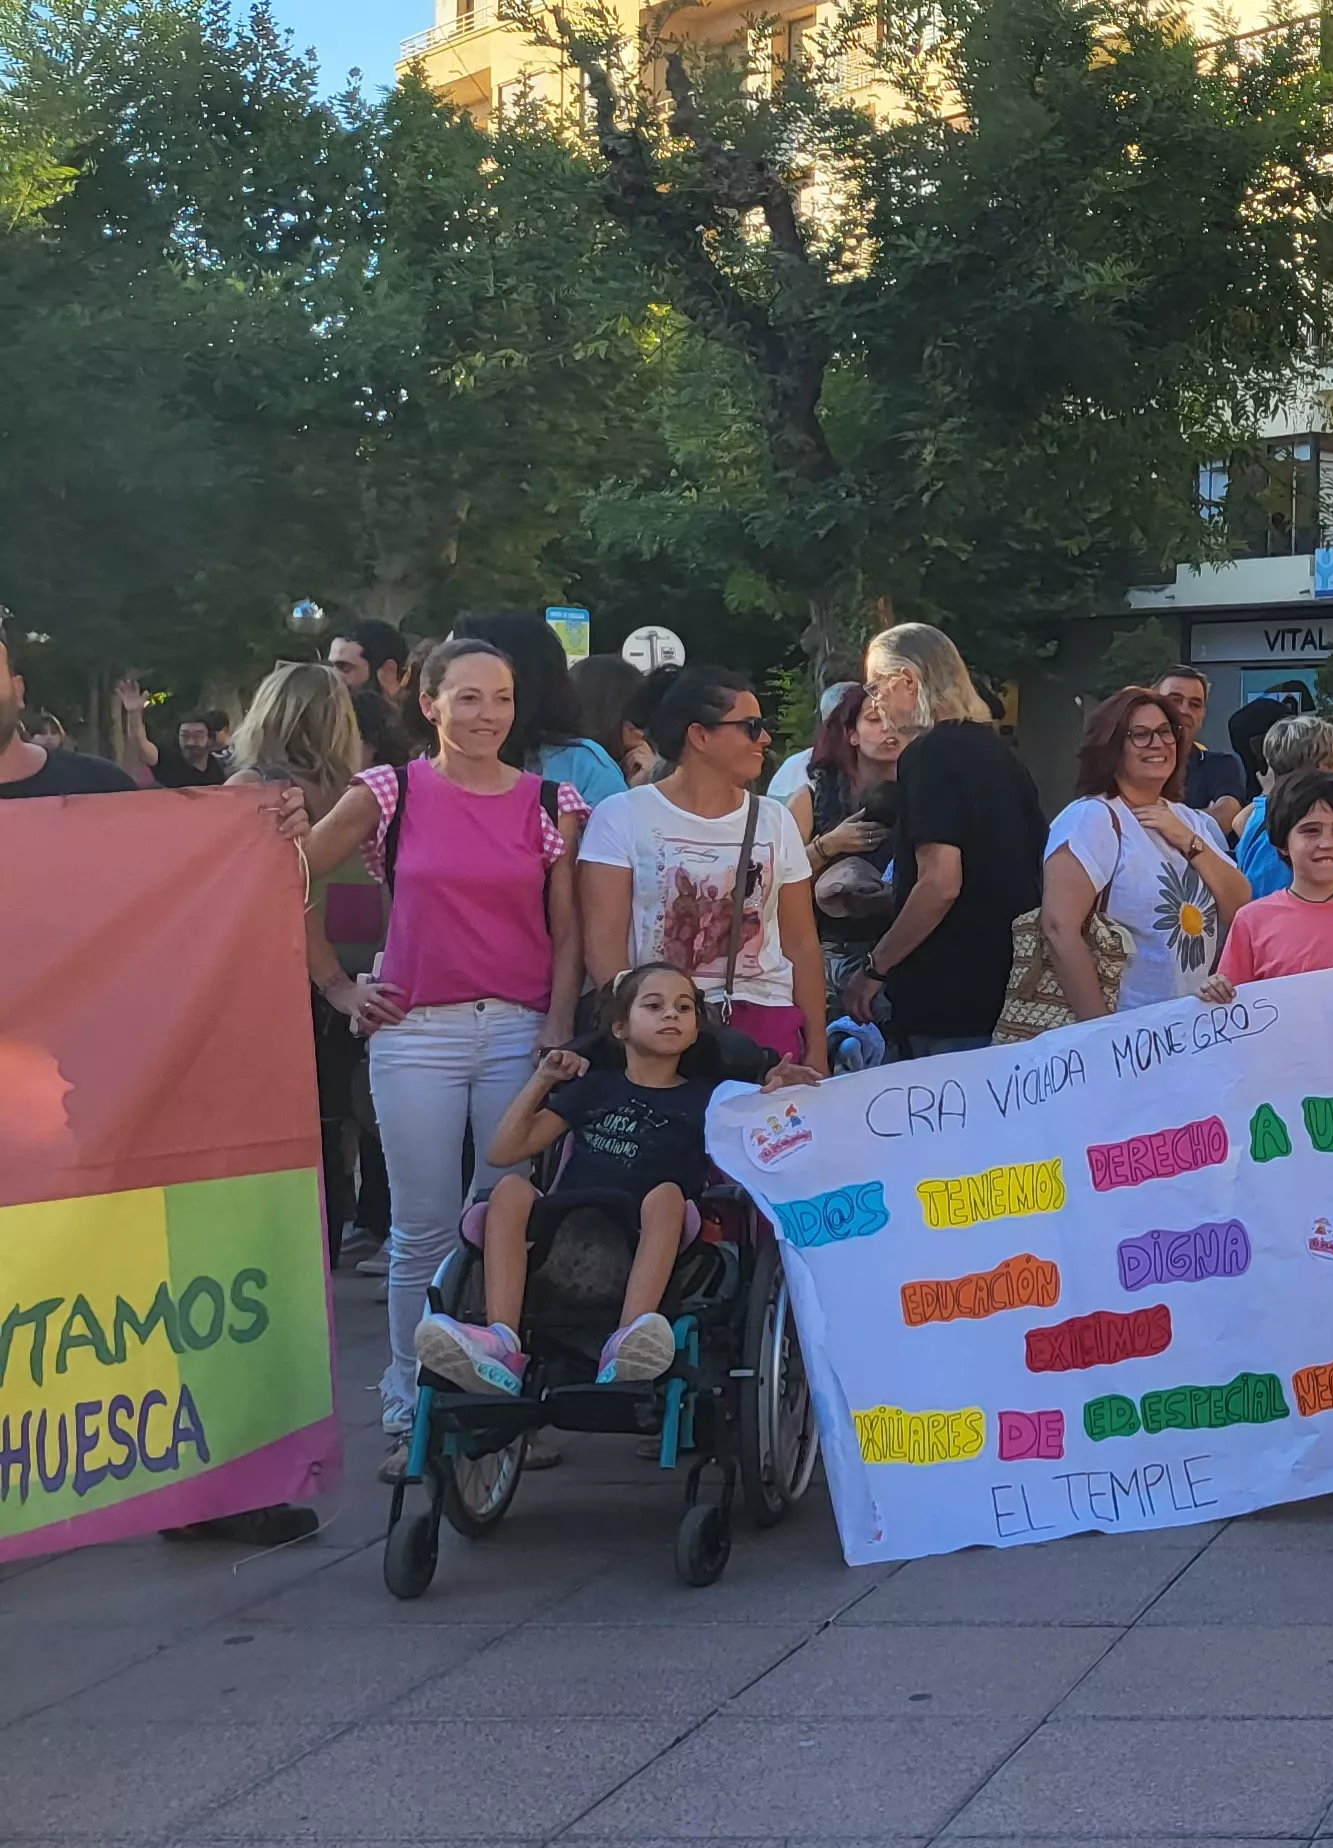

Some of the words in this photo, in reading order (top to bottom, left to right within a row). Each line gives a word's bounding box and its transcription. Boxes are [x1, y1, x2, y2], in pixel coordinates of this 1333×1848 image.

[866, 1079, 968, 1138] CRA
[1111, 998, 1279, 1079] MONEGROS
[915, 1160, 1065, 1228] TENEMOS
[1088, 1118, 1229, 1189] DERECHO
[1252, 1104, 1290, 1161] A
[1118, 1223, 1250, 1290] DIGNA
[0, 1383, 211, 1505] HUESCA
[998, 1410, 1064, 1460] DE
[1141, 1374, 1289, 1432] ESPECIAL
[991, 1484, 1056, 1537] EL
[1052, 1455, 1218, 1522] TEMPLE
